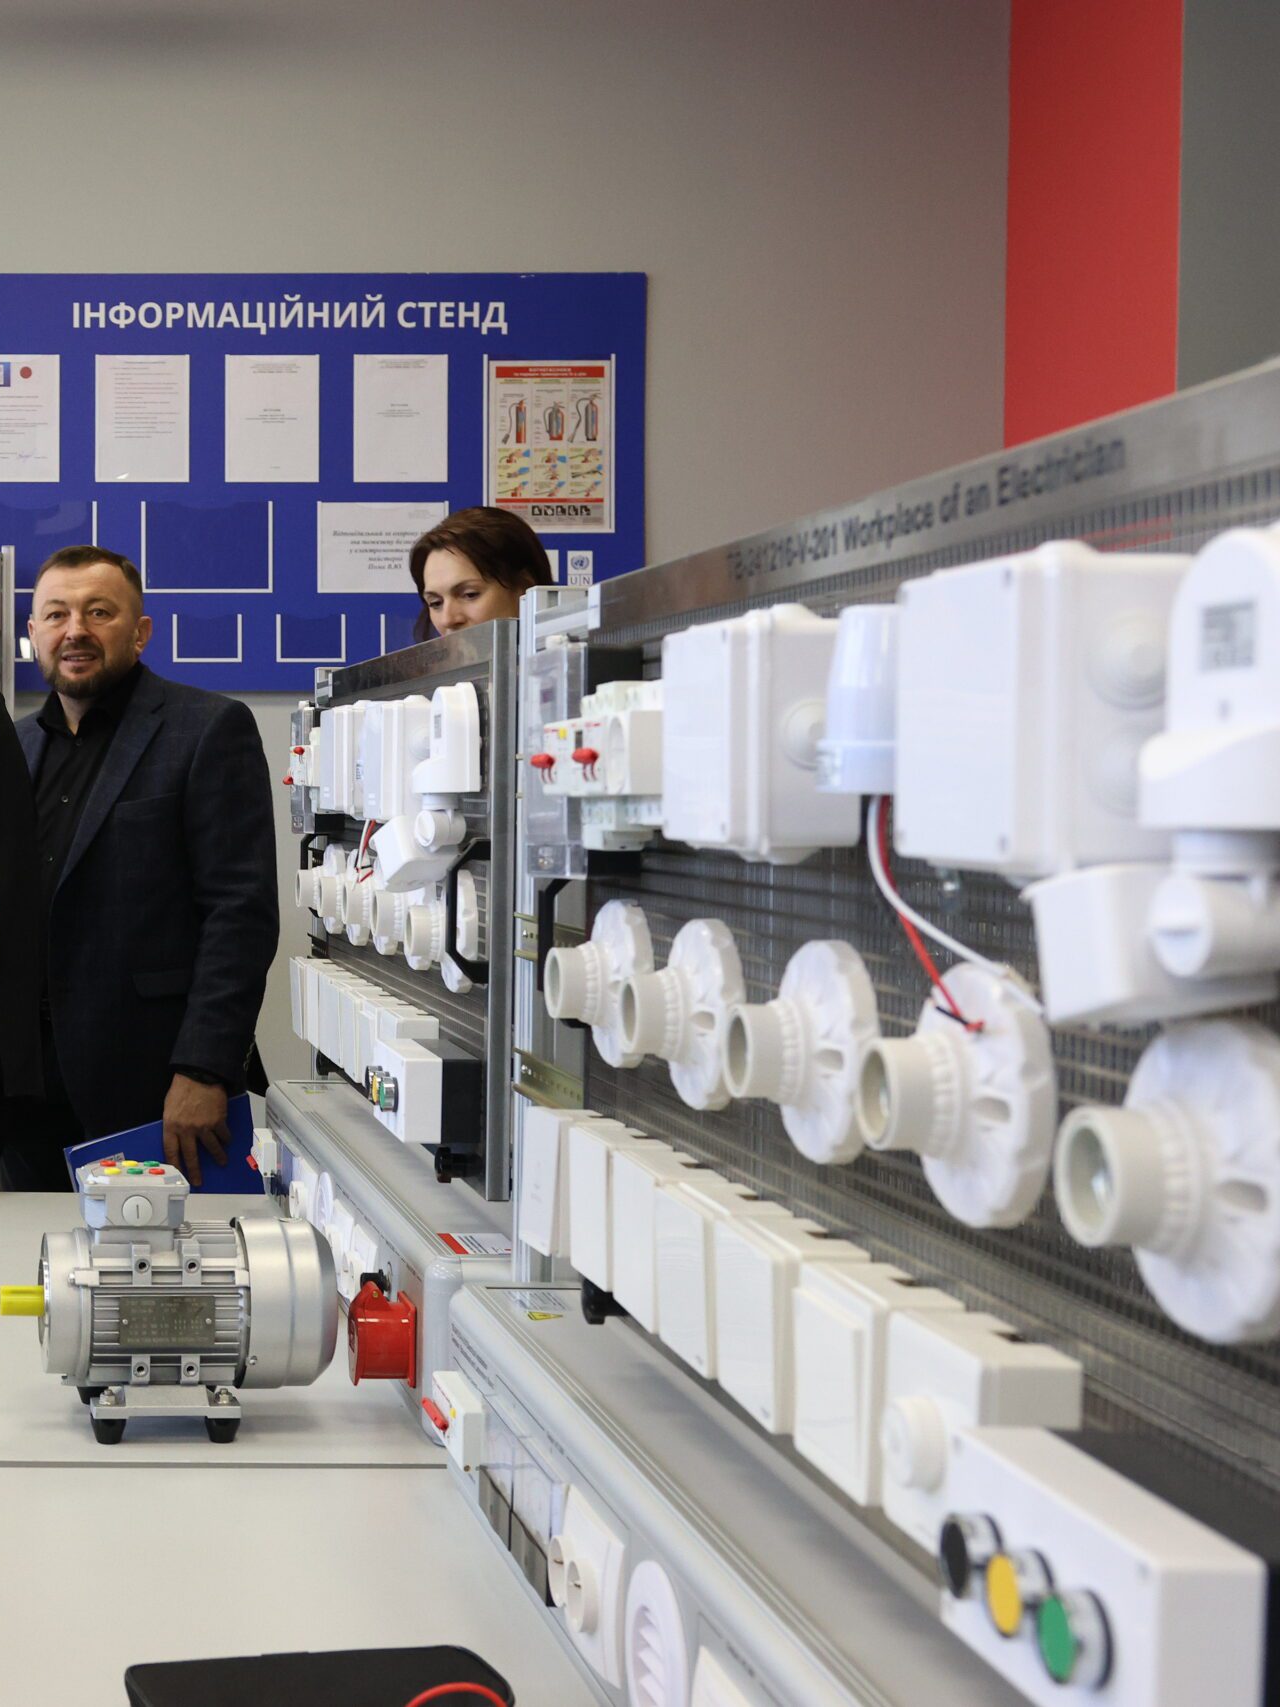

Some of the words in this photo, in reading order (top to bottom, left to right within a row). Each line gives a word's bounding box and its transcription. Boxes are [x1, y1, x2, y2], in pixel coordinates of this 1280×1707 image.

[72, 293, 386, 335] ІНФОРМАЦІЙНИЙ
[396, 301, 508, 335] СТЕНД
[843, 502, 934, 551] Workplace
[938, 481, 962, 523] of
[964, 486, 992, 518] an
[996, 437, 1128, 506] Electrician
[570, 576, 591, 585] UN
